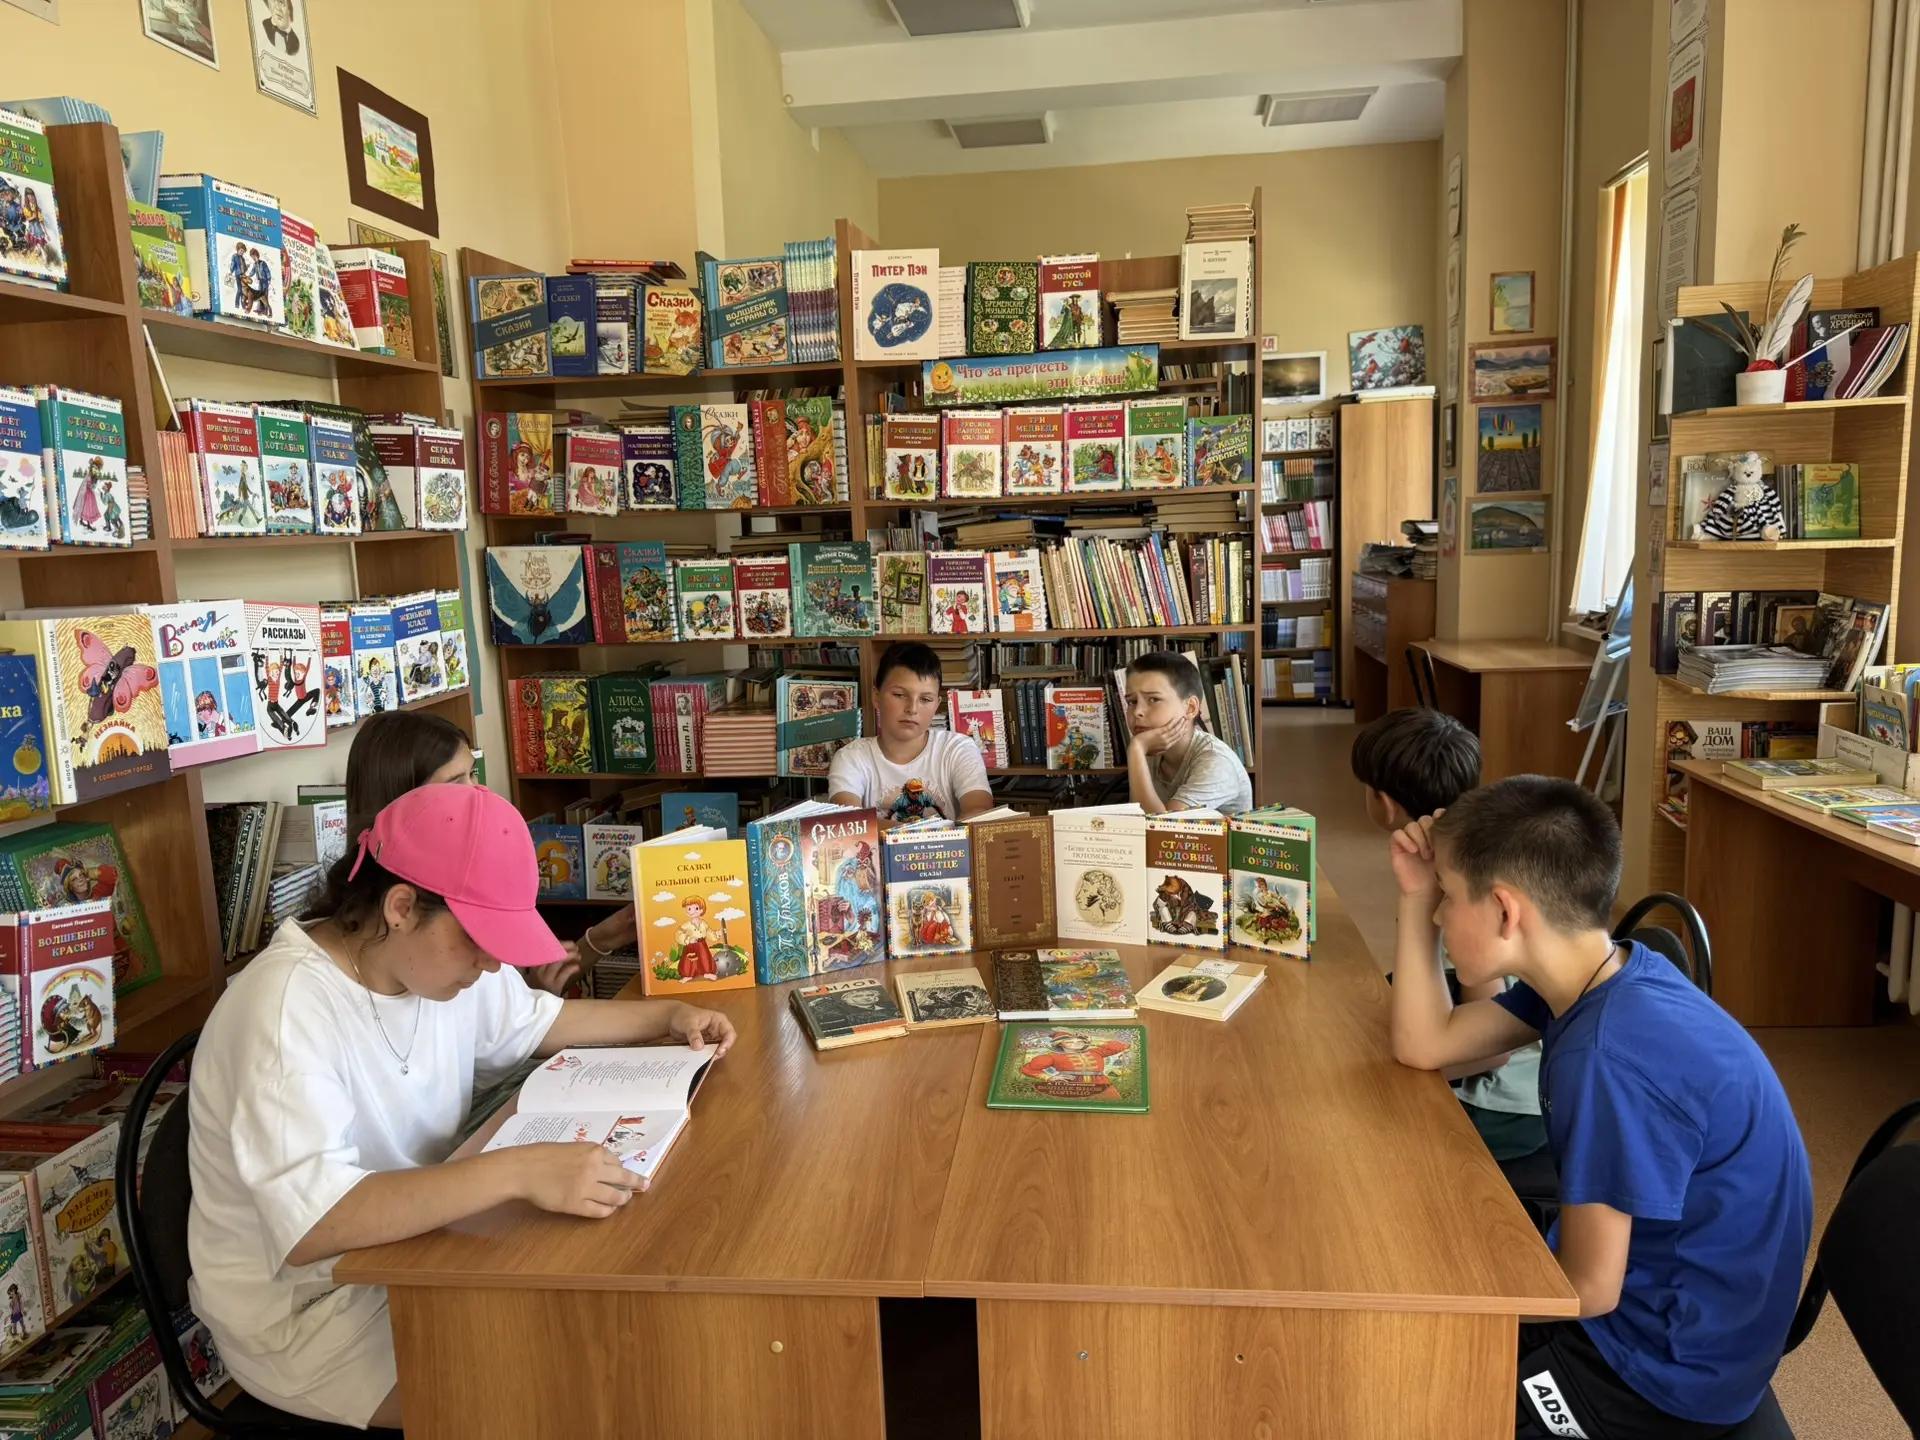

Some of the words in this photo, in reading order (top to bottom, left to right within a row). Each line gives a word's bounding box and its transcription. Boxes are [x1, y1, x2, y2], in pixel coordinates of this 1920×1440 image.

[0, 137, 36, 154] ШЕБНИК
[376, 259, 404, 275] Драгунский
[872, 265, 904, 277] ПИТЕР
[907, 264, 927, 276] ПЭН
[1052, 270, 1091, 280] ЗОЛОТОЙ
[1062, 280, 1083, 288] ГУСЬ
[726, 299, 776, 321] ВОЛШЕБНИК
[735, 310, 767, 326] СТРАНЫ
[768, 307, 778, 316] ОЗ
[495, 319, 533, 337] СКАЗКИ
[1830, 318, 1873, 329] ХРОНИКИ
[956, 365, 983, 379] Что
[987, 366, 1002, 377] за
[1007, 360, 1068, 378] прелесть
[1047, 377, 1068, 390] эти
[1074, 369, 1126, 387] сказки!
[704, 407, 738, 420] СКАЗКИ
[786, 402, 821, 415] СКАЗКИ
[68, 416, 118, 434] СТРЕКОЗА
[206, 424, 252, 436] ПРИКЛЮЧЕНИЯ
[753, 408, 762, 450] СКАЗКИ
[1016, 424, 1059, 433] МЕДВЕДЯ
[76, 430, 121, 446] МУРАВЕЙ
[222, 435, 240, 443] ВАСИ
[270, 431, 298, 441] СТАРИК
[1213, 433, 1248, 449] СКАЗКИ
[211, 442, 253, 453] КУРОЛЕСОВА
[265, 441, 304, 453] ХОТТАБЫЧ
[430, 445, 454, 454] СЕРАЯ
[322, 450, 349, 460] СКАЗКИ
[430, 455, 456, 465] ШЕЙКА
[1206, 446, 1248, 464] ДОБЛЕСТИ
[687, 574, 728, 582] СКАЗКИ
[399, 609, 432, 622] ЖЕНЬКИН
[407, 619, 426, 628] КЛАД
[262, 627, 306, 640] РАССКАЗЫ
[608, 696, 644, 706] АЛИСА
[93, 720, 136, 739] НЕЗНАЙКА
[1708, 727, 1731, 735] ВАШ
[1702, 736, 1734, 747] ДОМ
[682, 733, 692, 772] Кэролл
[64, 759, 72, 781] НОСОВ
[99, 770, 131, 781] СОЛНЕЧНОМ
[133, 764, 153, 774] ГОРОДЕ
[238, 813, 253, 865] СКАЗКИ
[811, 820, 868, 845] СКАЗЫ
[1161, 841, 1211, 852] СТАРИК-
[894, 849, 965, 863] СЕРЕБРЯНОЕ
[1158, 851, 1214, 863] ГОДОВИК
[677, 863, 712, 872] СКАЗКИ
[901, 860, 959, 872] КОПЫТЦЕ
[1183, 863, 1218, 871] ПОСЛОВИЦЫ
[1242, 856, 1300, 872] ГОРБУНОК
[655, 876, 700, 887] БОЛЬШОЙ
[703, 874, 735, 884] СЕМЬИ
[52, 922, 73, 930] Евгений
[38, 927, 108, 948] ВОЛШЕБНЫЕ
[52, 941, 95, 957] КРАСКИ
[79, 1133, 109, 1155] СОТНИКОВ
[1532, 1384, 1569, 1425] ADS
